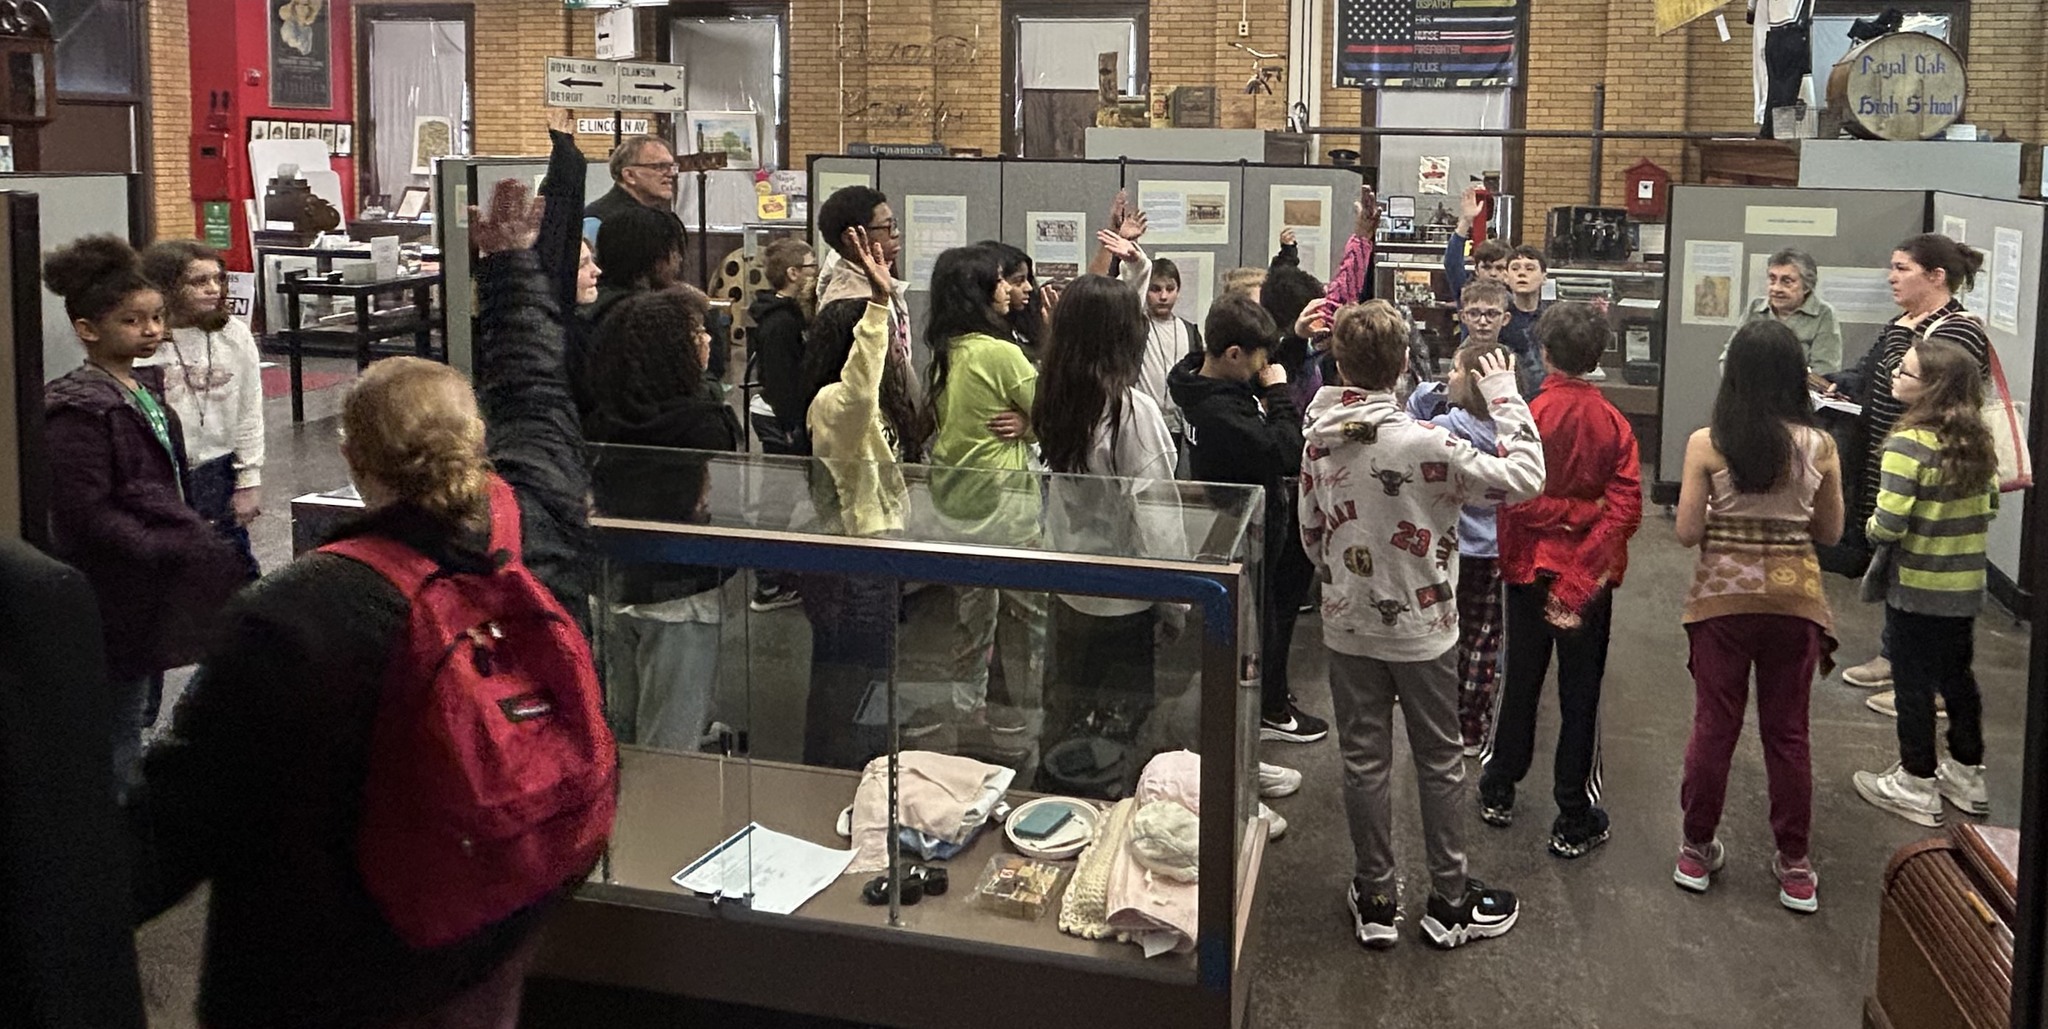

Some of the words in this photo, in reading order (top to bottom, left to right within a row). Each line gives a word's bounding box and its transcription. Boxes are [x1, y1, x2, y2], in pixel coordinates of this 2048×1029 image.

[1415, 0, 1451, 9] DISPATCH
[1414, 30, 1439, 41] NURSE
[1414, 44, 1461, 55] FIREFIGHTER
[550, 62, 576, 74] ROYAL
[581, 64, 597, 74] OAK
[1413, 62, 1440, 73] POLICE
[1915, 53, 1946, 75] Oak
[622, 66, 656, 78] CLAWSON
[676, 70, 682, 80] 2
[1412, 77, 1447, 88] MILITARY
[550, 91, 583, 102] DETROIT
[606, 94, 616, 104] 12
[622, 95, 653, 105] PONTIAC
[1858, 94, 1899, 118] High
[579, 120, 586, 132] E
[588, 120, 631, 132] LINCON
[634, 121, 646, 133] AV
[869, 145, 923, 155] Cinnamon
[1390, 520, 1432, 558] 23
